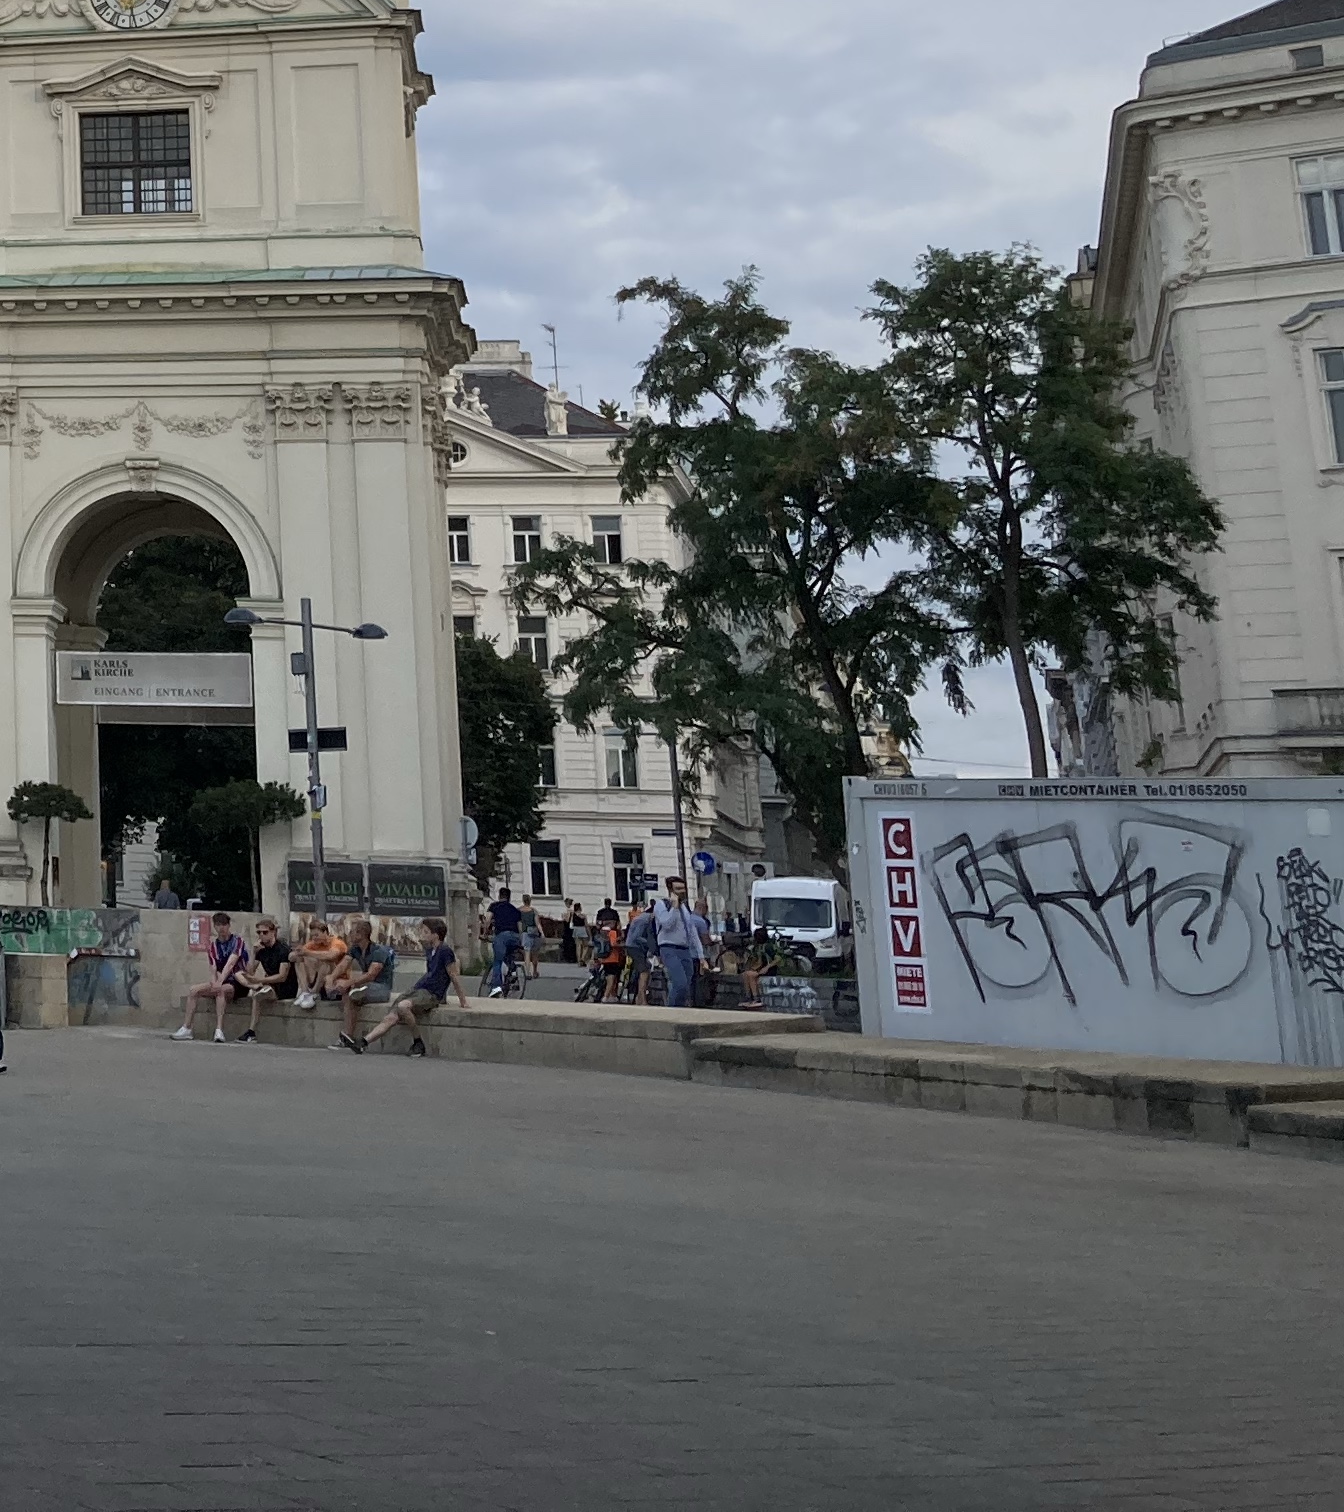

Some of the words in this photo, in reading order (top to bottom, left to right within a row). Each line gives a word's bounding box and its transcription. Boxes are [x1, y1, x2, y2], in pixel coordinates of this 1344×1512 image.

[93, 659, 128, 669] KARLS
[94, 668, 134, 677] KIRCHE
[94, 687, 144, 697] EINGANG
[155, 688, 215, 698] ENTRANCE
[1029, 784, 1138, 797] MIETCONTAINER
[375, 881, 439, 898] VIVALDI
